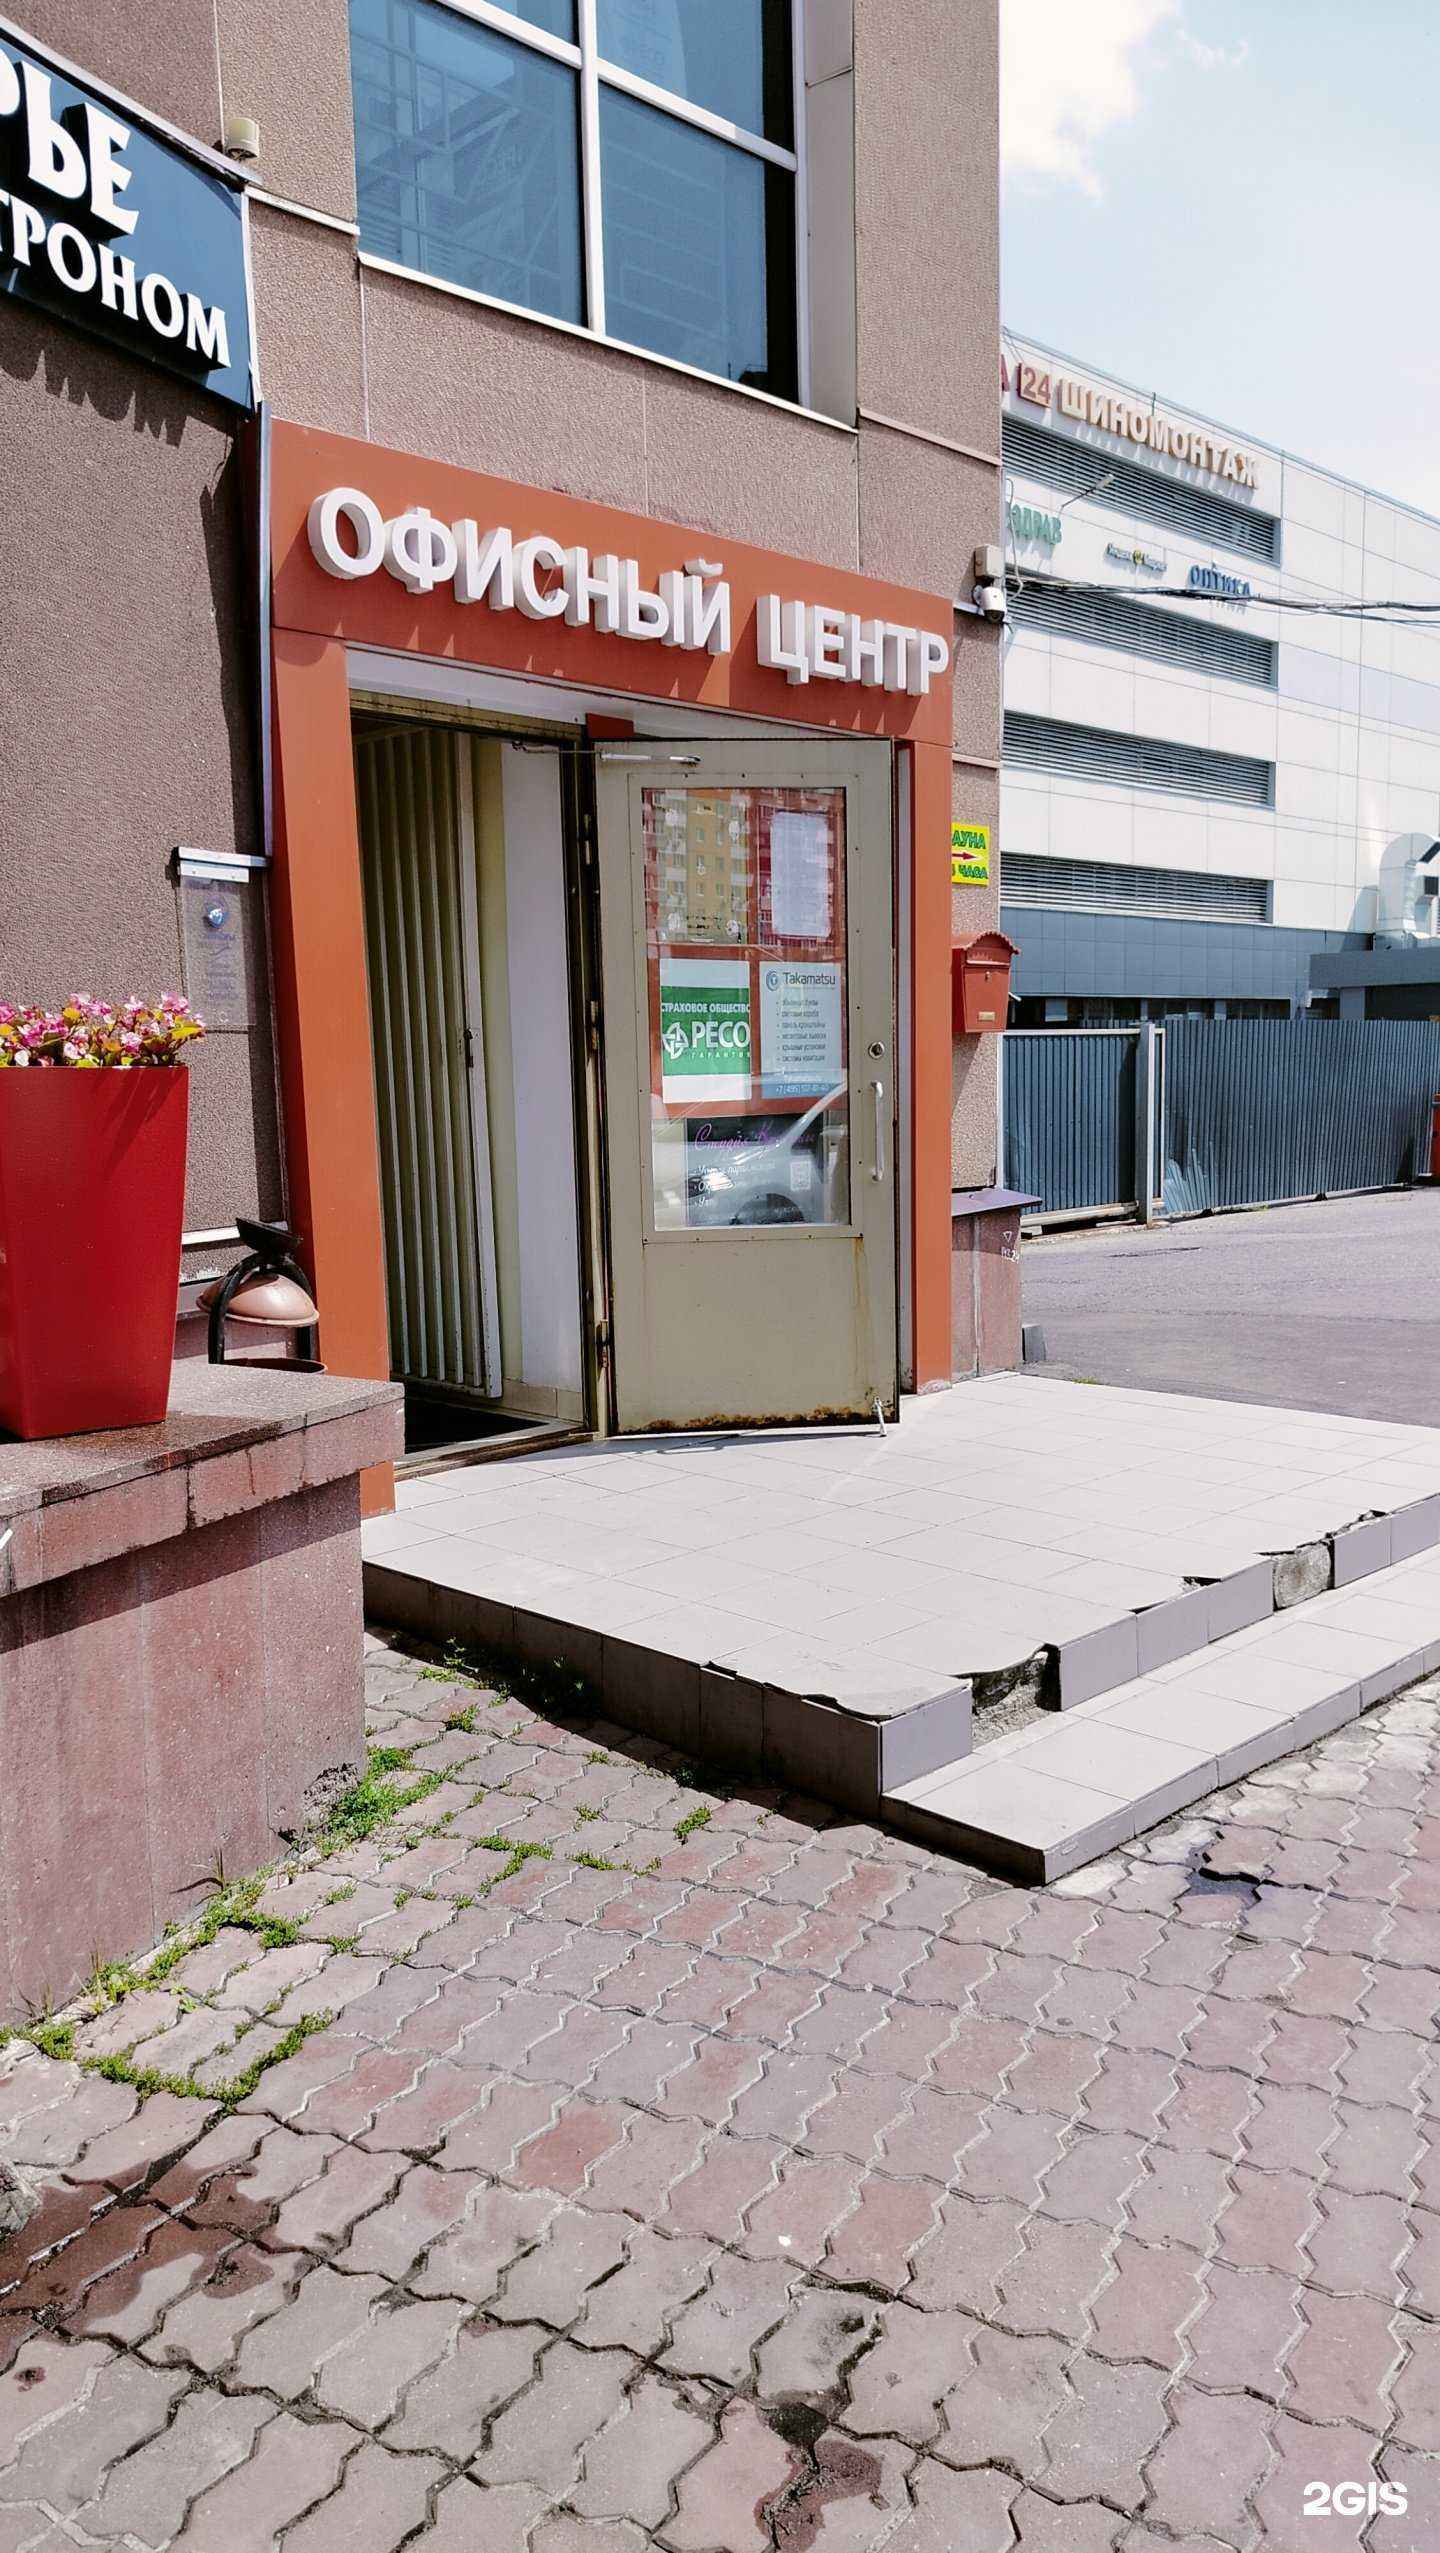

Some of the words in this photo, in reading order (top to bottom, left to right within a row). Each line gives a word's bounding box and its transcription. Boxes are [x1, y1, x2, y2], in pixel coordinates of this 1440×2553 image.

[0, 190, 231, 368] РОНОМ
[1022, 367, 1052, 405] 24
[1056, 377, 1258, 489] ШИНОМОНТАЖ
[307, 487, 732, 656] ОФИСНЫЙ
[757, 594, 949, 696] ЦЕНТР
[1190, 565, 1251, 596] ОПТИКА
[783, 971, 836, 985] Takamatsu
[692, 1021, 751, 1048] РЕСО
